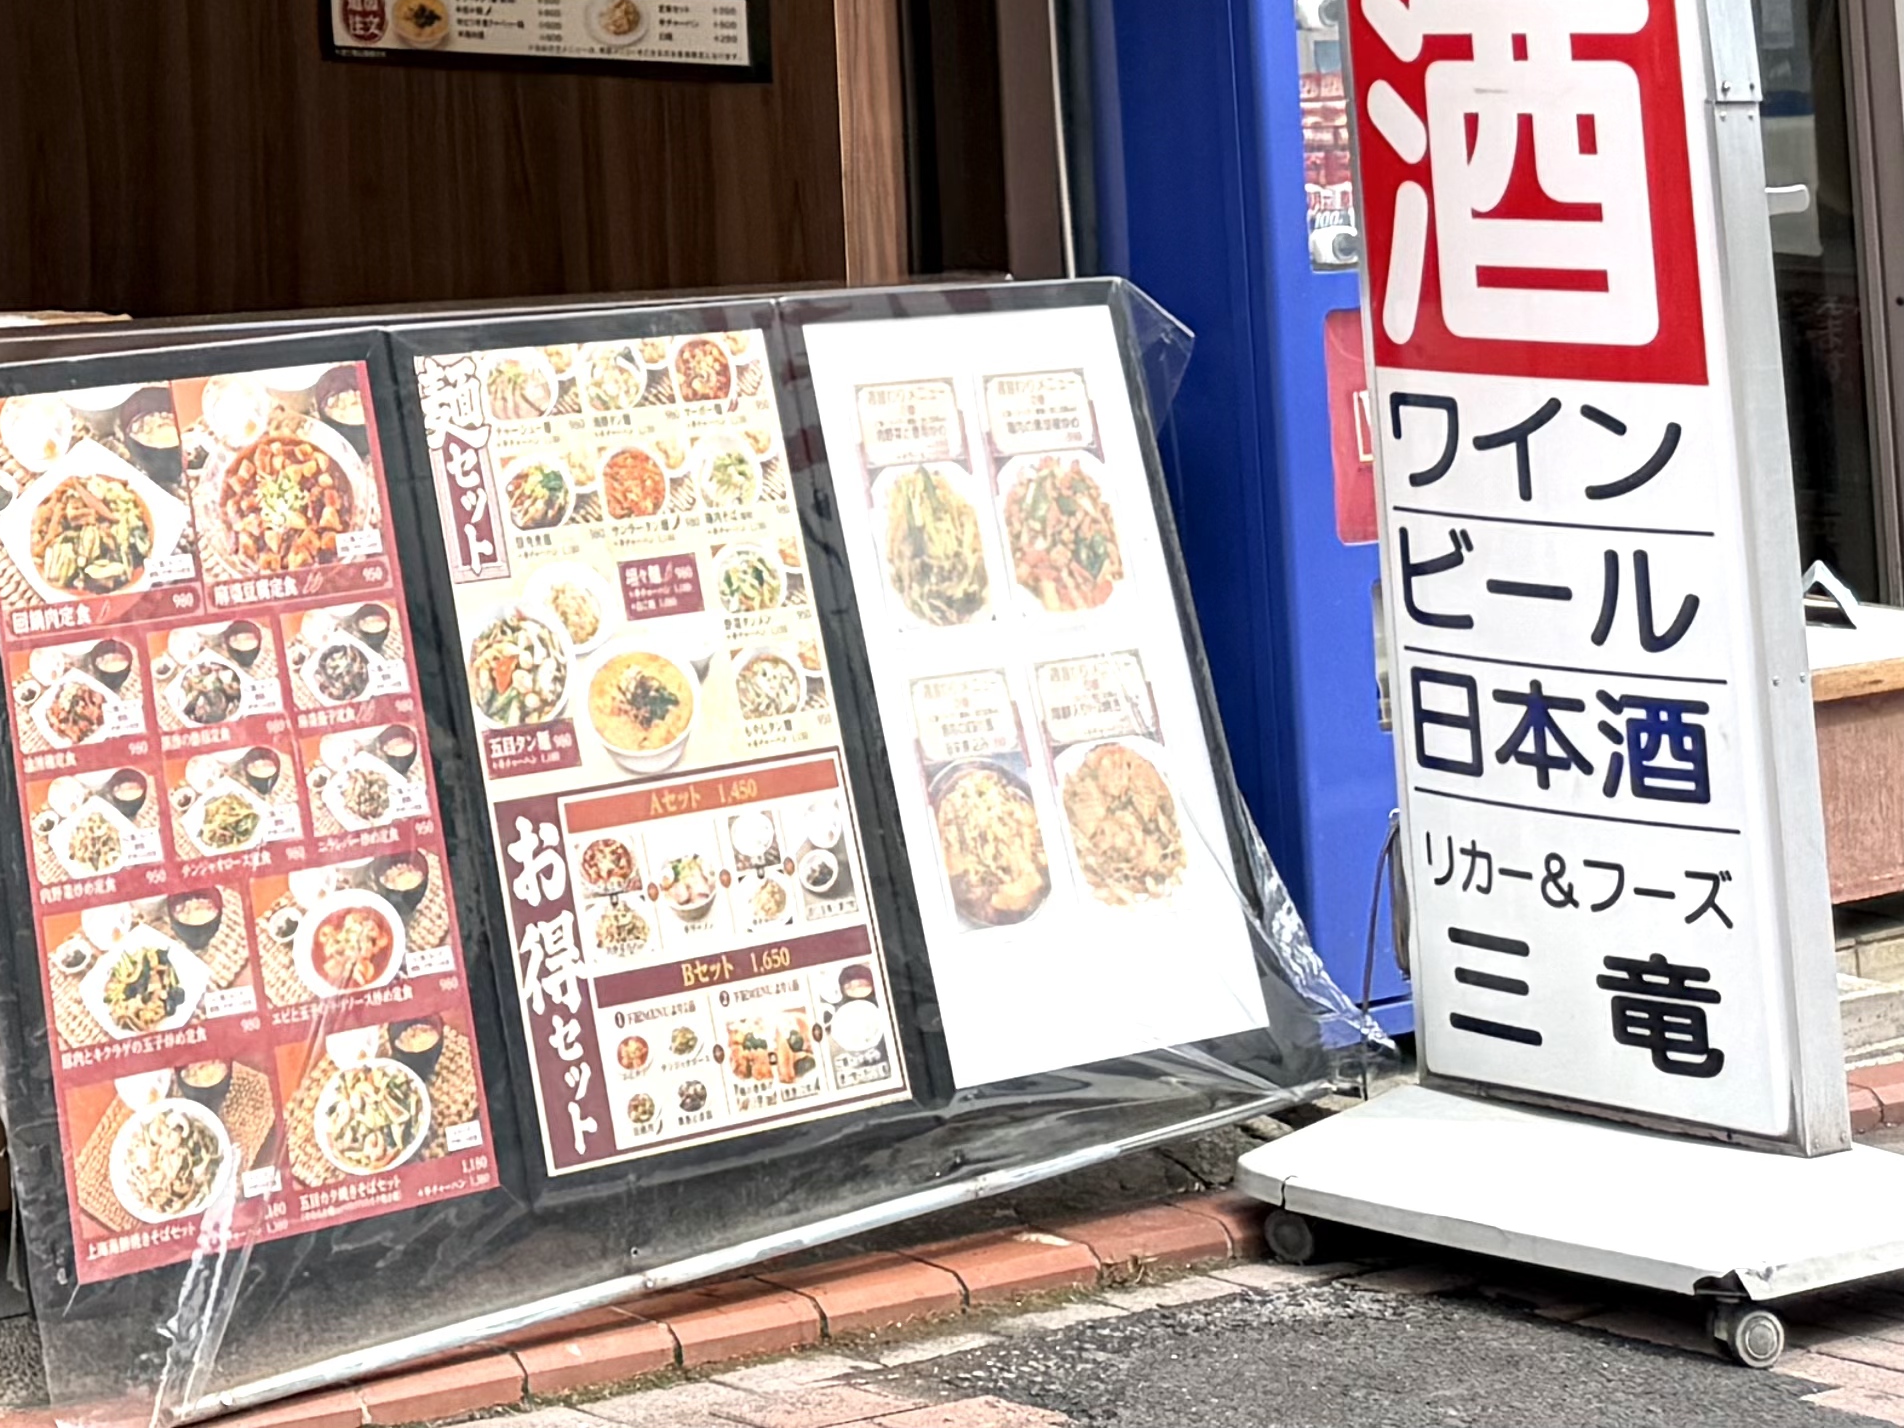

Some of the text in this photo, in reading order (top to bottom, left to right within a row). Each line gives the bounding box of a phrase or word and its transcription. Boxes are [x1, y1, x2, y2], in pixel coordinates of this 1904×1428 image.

[1389, 391, 1683, 502] ワイン
[1398, 525, 1701, 655] ビール
[1410, 665, 1712, 806] 日本酒
[1425, 829, 1734, 930] リカー&フーズ
[506, 814, 600, 1157] お得セット
[1446, 926, 1725, 1079] 三竜
